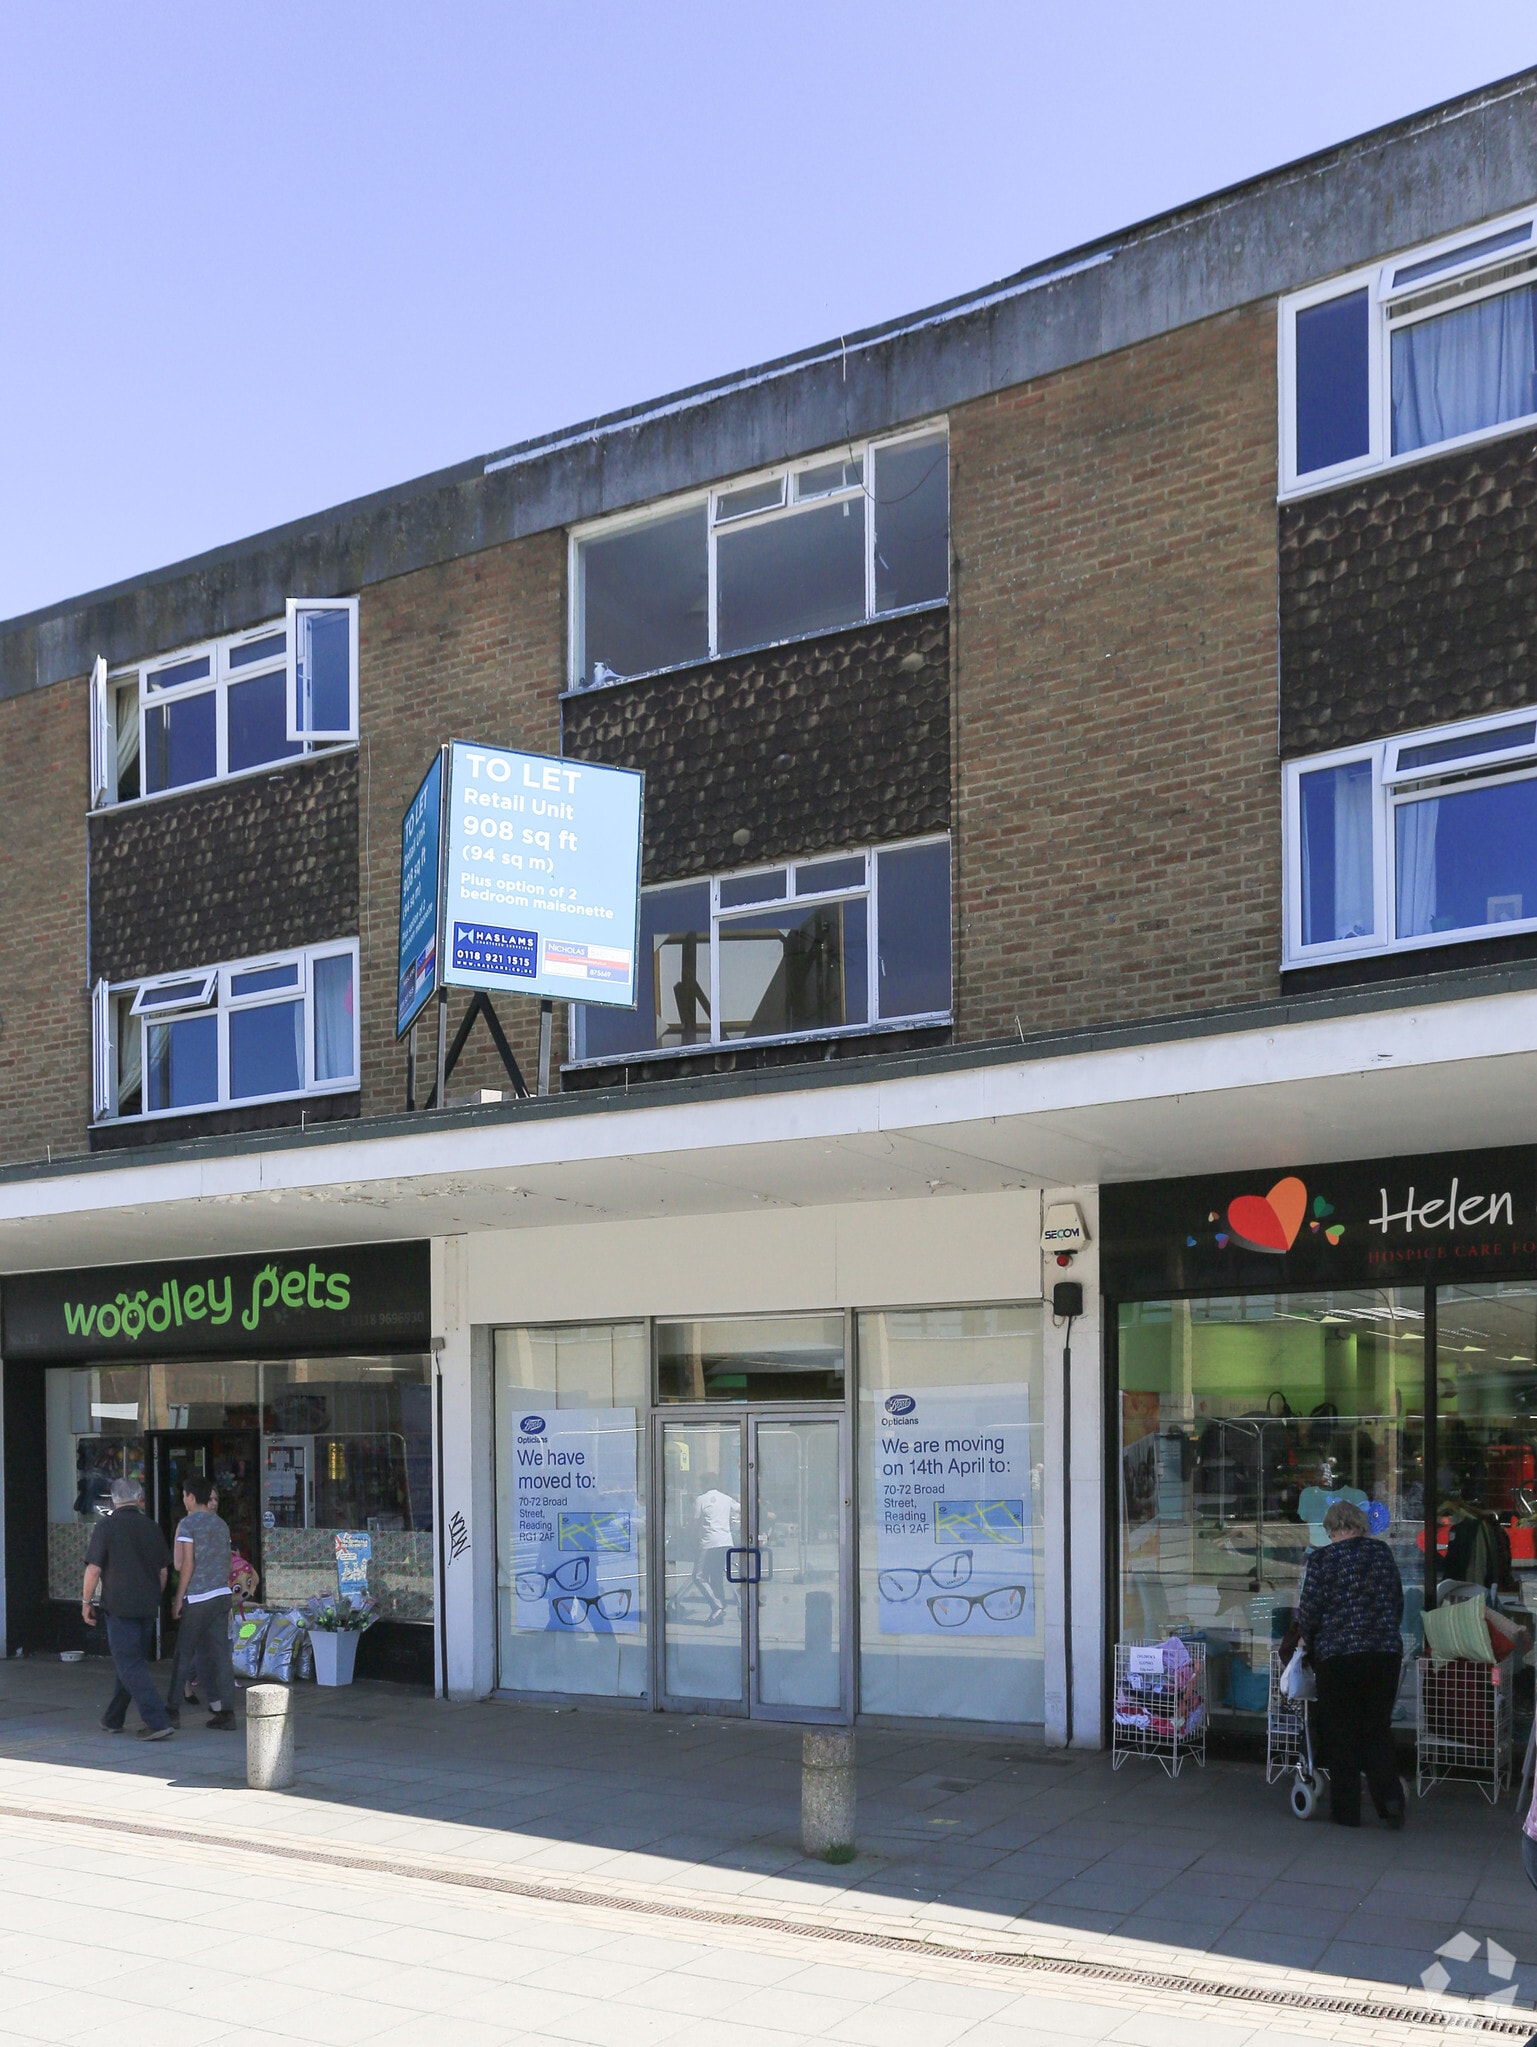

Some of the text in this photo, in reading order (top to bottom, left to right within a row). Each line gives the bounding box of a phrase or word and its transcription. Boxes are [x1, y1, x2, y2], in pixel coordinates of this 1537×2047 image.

[465, 753, 582, 794] TO LET
[415, 784, 429, 825] LET
[464, 787, 574, 820] Retail Unit
[463, 815, 578, 852] 908 sq ft
[462, 844, 554, 874] (94 sq m)
[460, 872, 578, 900] Plus option of 2
[460, 886, 615, 919] bedroom maisonette
[476, 931, 534, 947] HASLAMS
[457, 949, 530, 967] 0118 921 1515
[548, 943, 586, 956] NICHOLAS
[1368, 1177, 1514, 1234] Helen
[1044, 1228, 1080, 1240] SECOM
[1367, 1246, 1447, 1265] HOSPICE
[1454, 1243, 1502, 1257] CARE
[241, 1263, 351, 1331] pets
[887, 1397, 912, 1412] Boots
[881, 1417, 919, 1427] Opticians
[881, 1435, 1004, 1454] We are moving
[516, 1448, 585, 1466] We have
[882, 1457, 1011, 1477] on 14th April to:
[518, 1472, 596, 1489] moved to:
[883, 1483, 945, 1495] 70-72 Broad
[518, 1496, 568, 1507] 70-72 Broad
[884, 1498, 917, 1509] Street,
[519, 1508, 545, 1519] Street,
[884, 1510, 926, 1523] Reading
[519, 1520, 552, 1532] Reading
[885, 1523, 930, 1534] RG1 2AF
[519, 1532, 555, 1542] RG1 2AF
